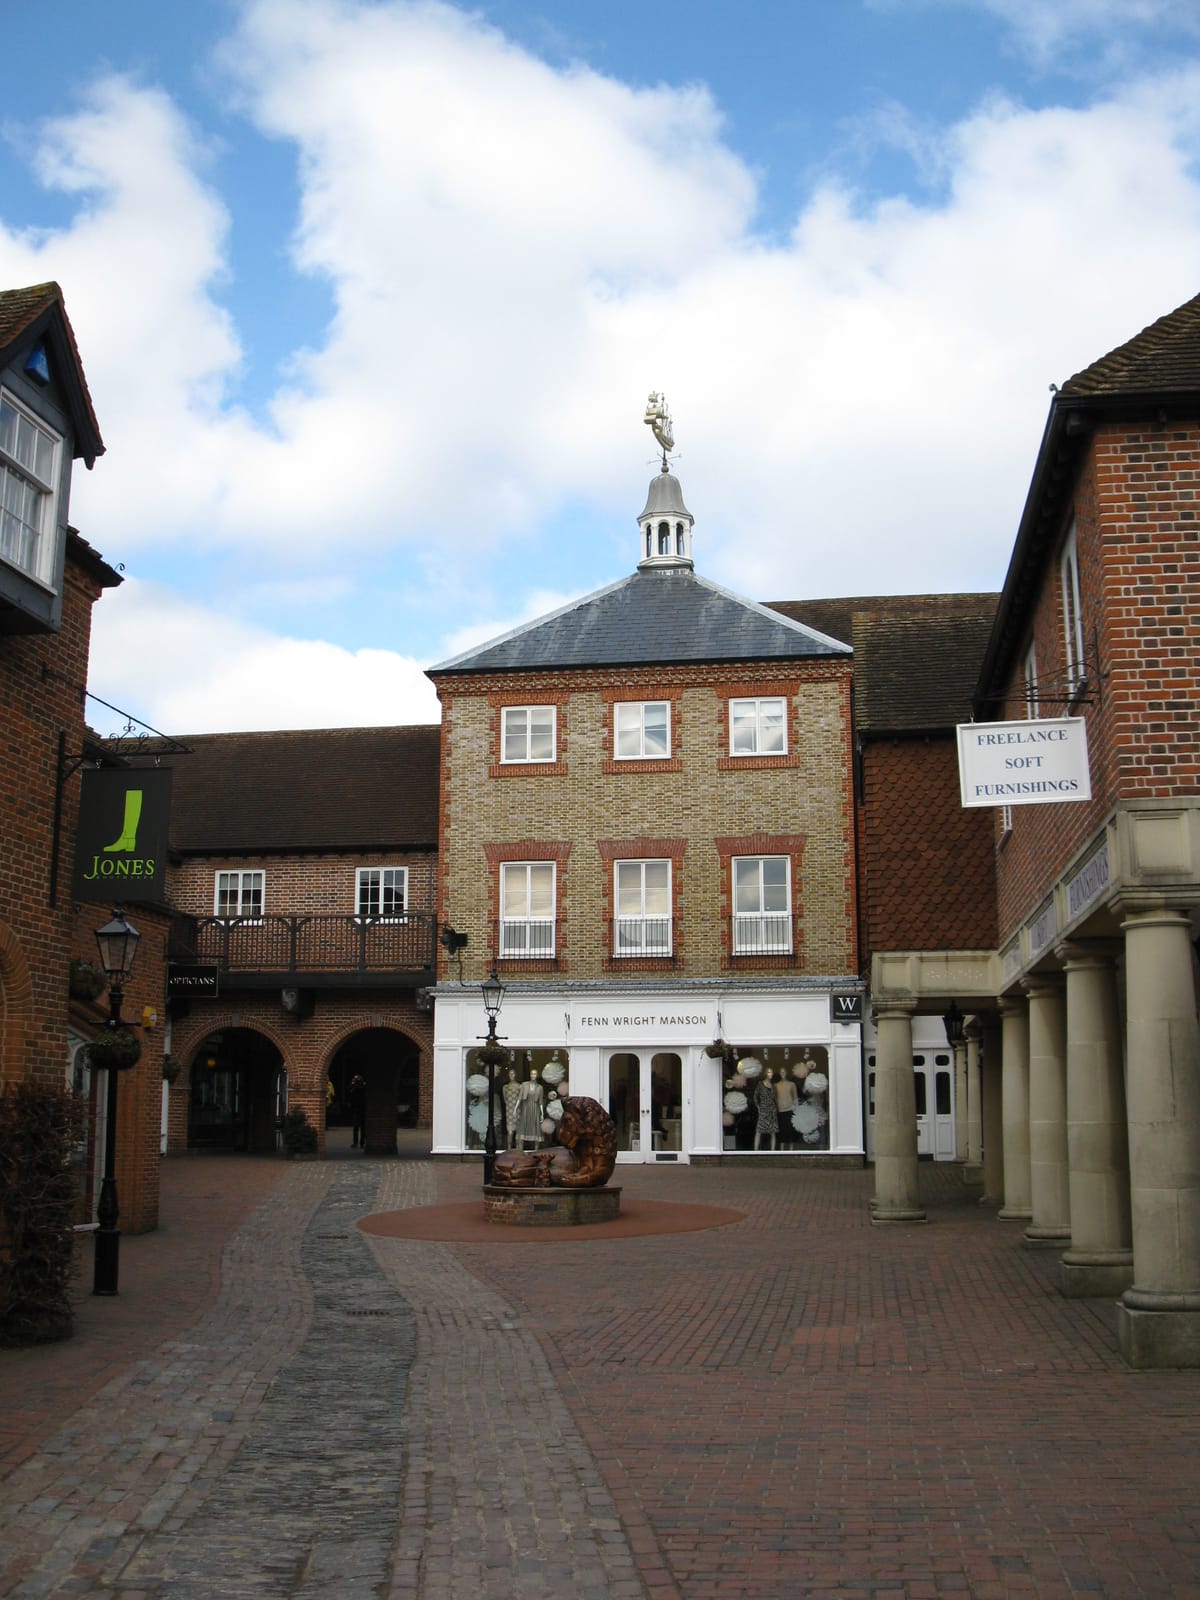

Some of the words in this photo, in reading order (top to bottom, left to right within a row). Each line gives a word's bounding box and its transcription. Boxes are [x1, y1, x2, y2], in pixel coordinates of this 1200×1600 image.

[977, 729, 1068, 745] FREELANCE
[1005, 756, 1044, 769] SOFT
[975, 779, 1078, 796] FURNISHINGS
[83, 855, 155, 880] JONES
[169, 976, 215, 985] OPTICIANS
[837, 997, 857, 1011] W
[581, 1017, 609, 1026] FENN
[613, 1016, 656, 1026] WRIGHT
[659, 1015, 707, 1025] MANSON
